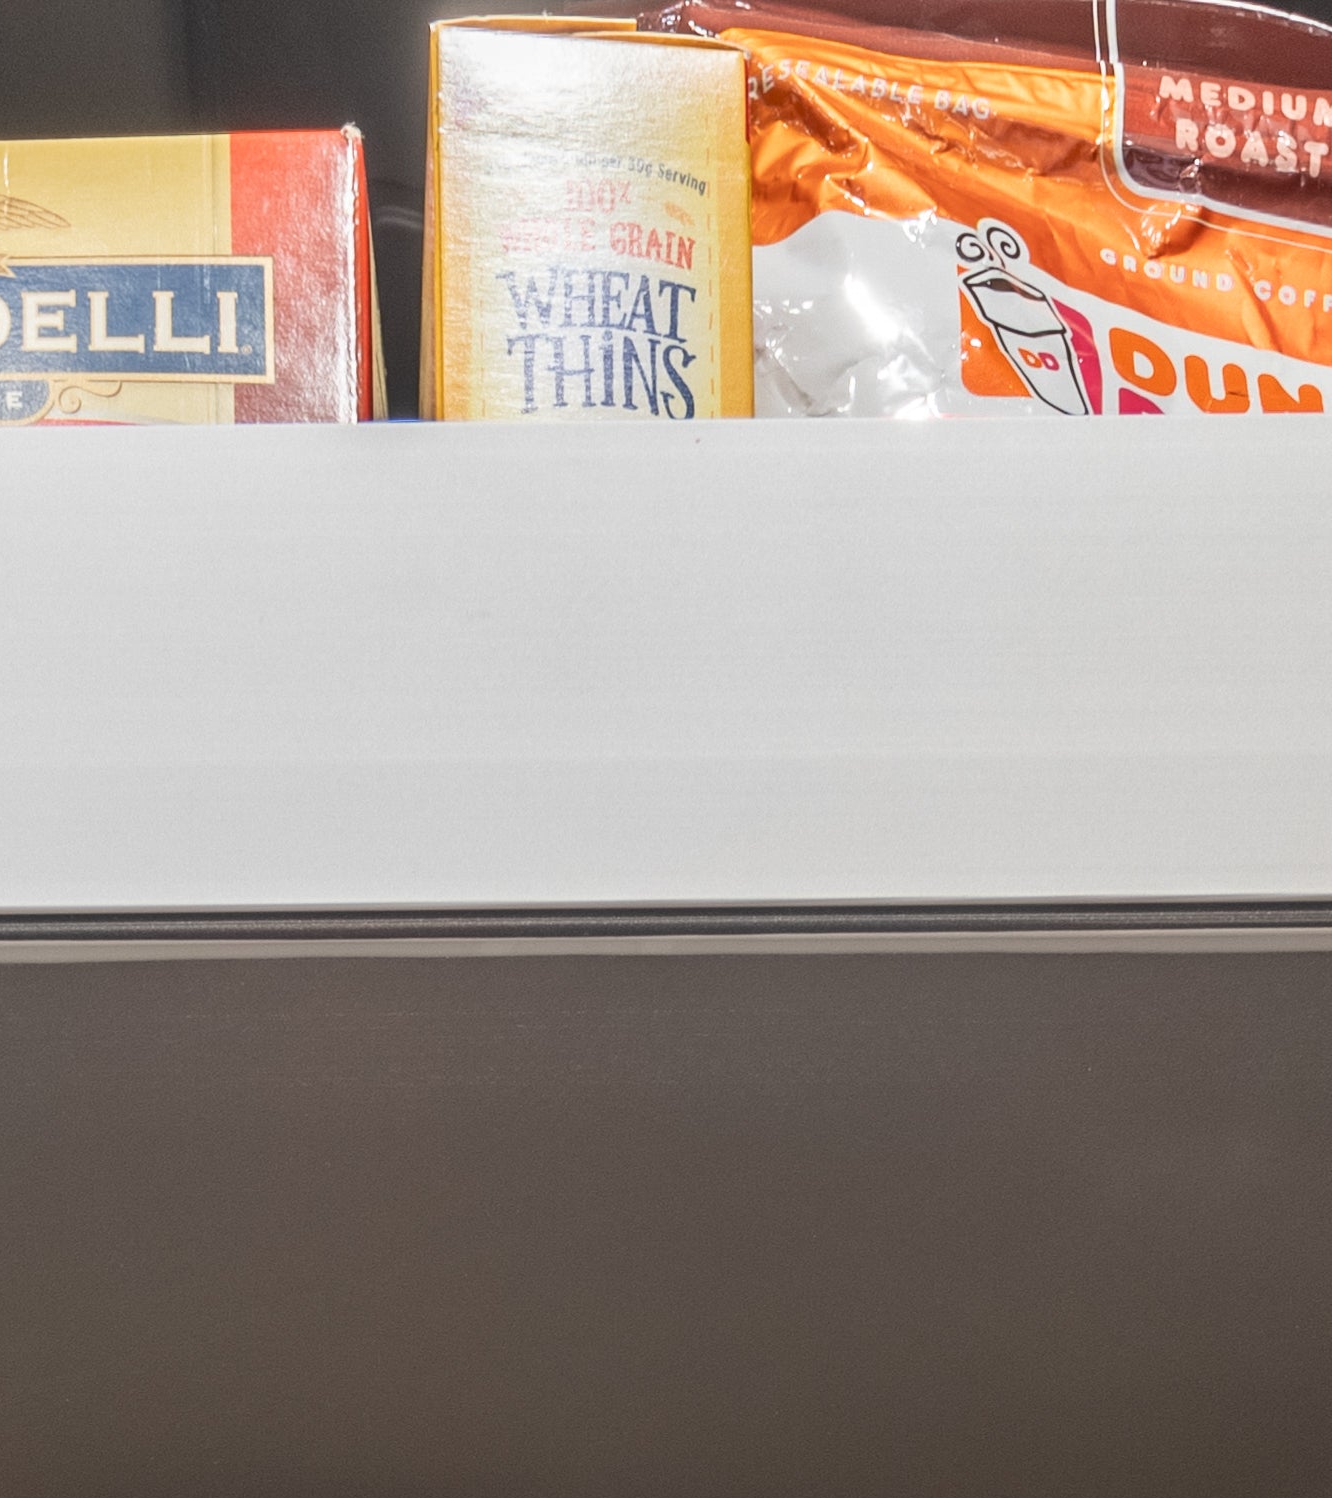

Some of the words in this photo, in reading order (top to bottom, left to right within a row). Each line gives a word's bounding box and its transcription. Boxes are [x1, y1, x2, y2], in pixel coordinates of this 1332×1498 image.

[934, 89, 991, 120] BAG
[1175, 118, 1329, 178] ROAST
[658, 163, 707, 196] Serving
[610, 221, 696, 271] GRAIN
[1100, 248, 1234, 292] GROUND
[496, 265, 697, 344] WHEAT
